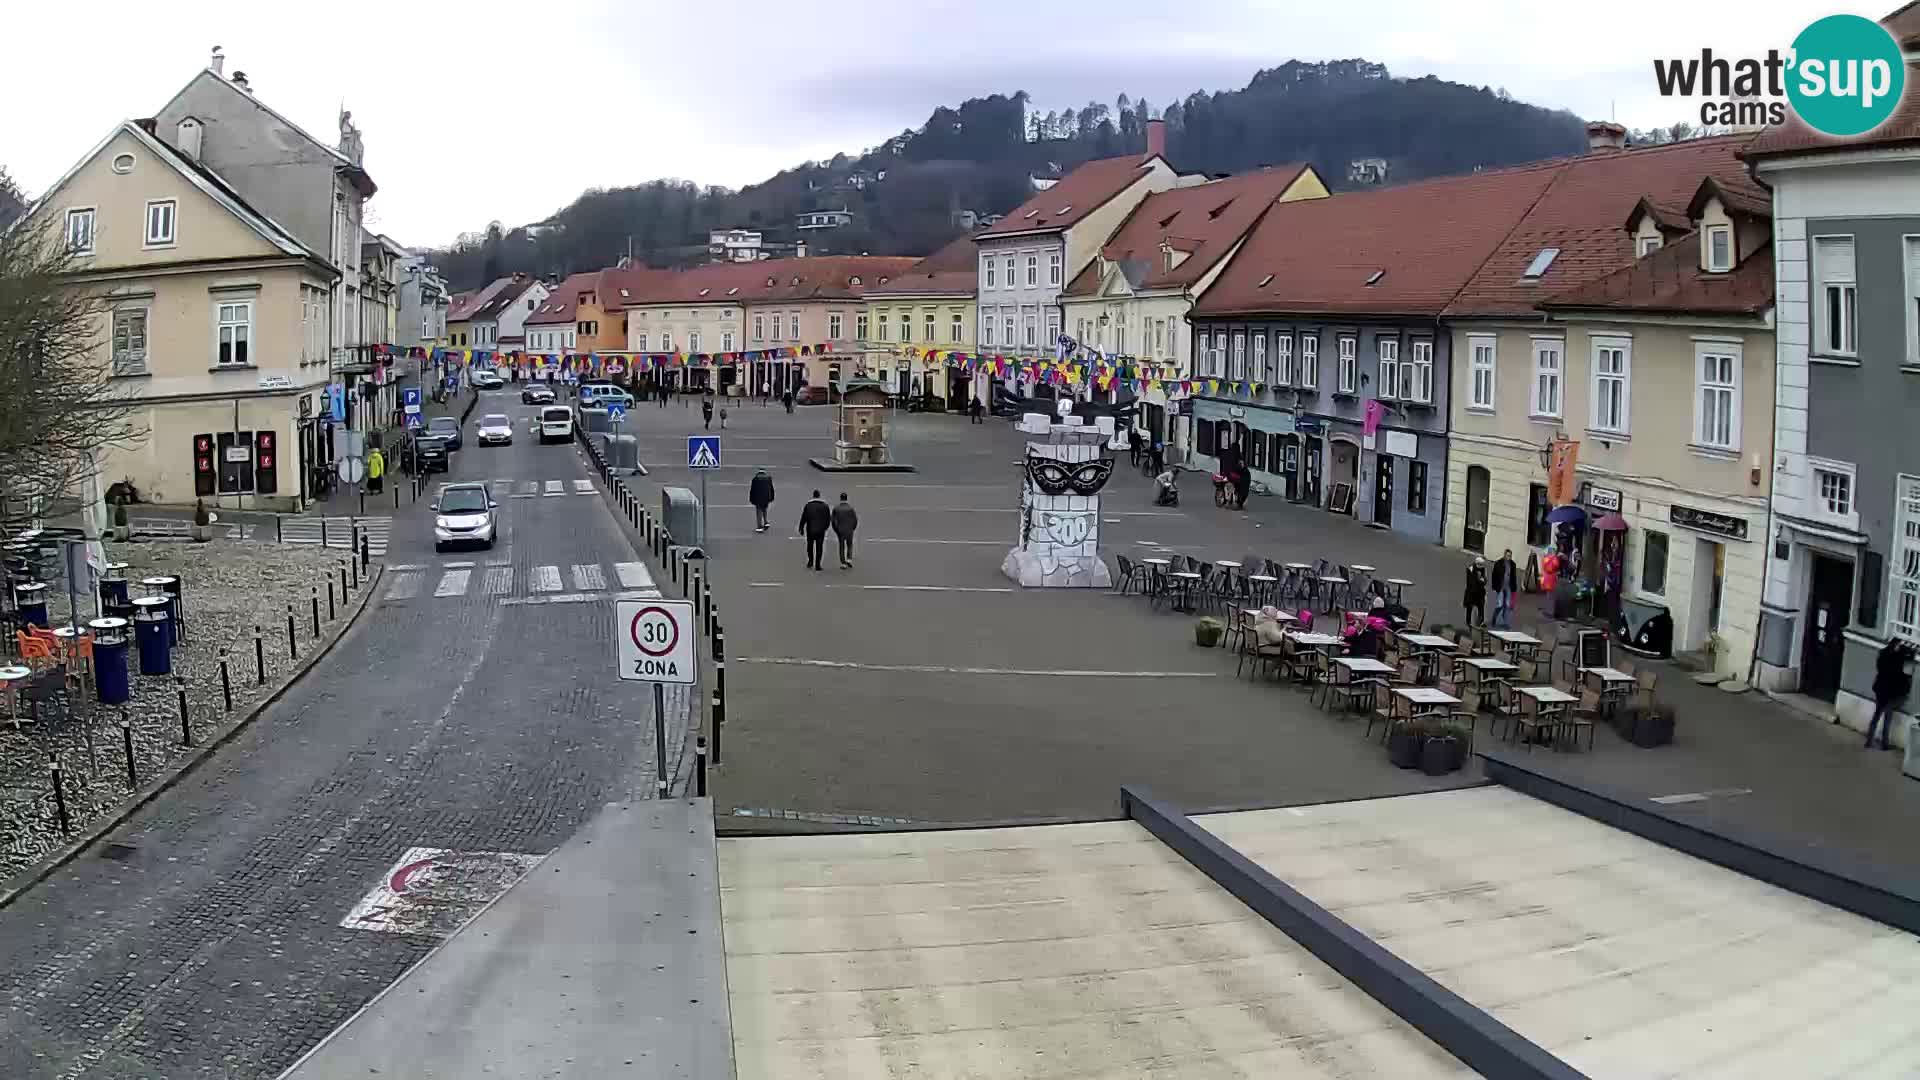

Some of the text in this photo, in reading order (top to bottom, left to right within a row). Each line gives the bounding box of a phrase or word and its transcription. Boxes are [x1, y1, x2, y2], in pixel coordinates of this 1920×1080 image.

[408, 391, 416, 403] P
[644, 622, 668, 644] 30
[634, 659, 679, 677] ZONA
